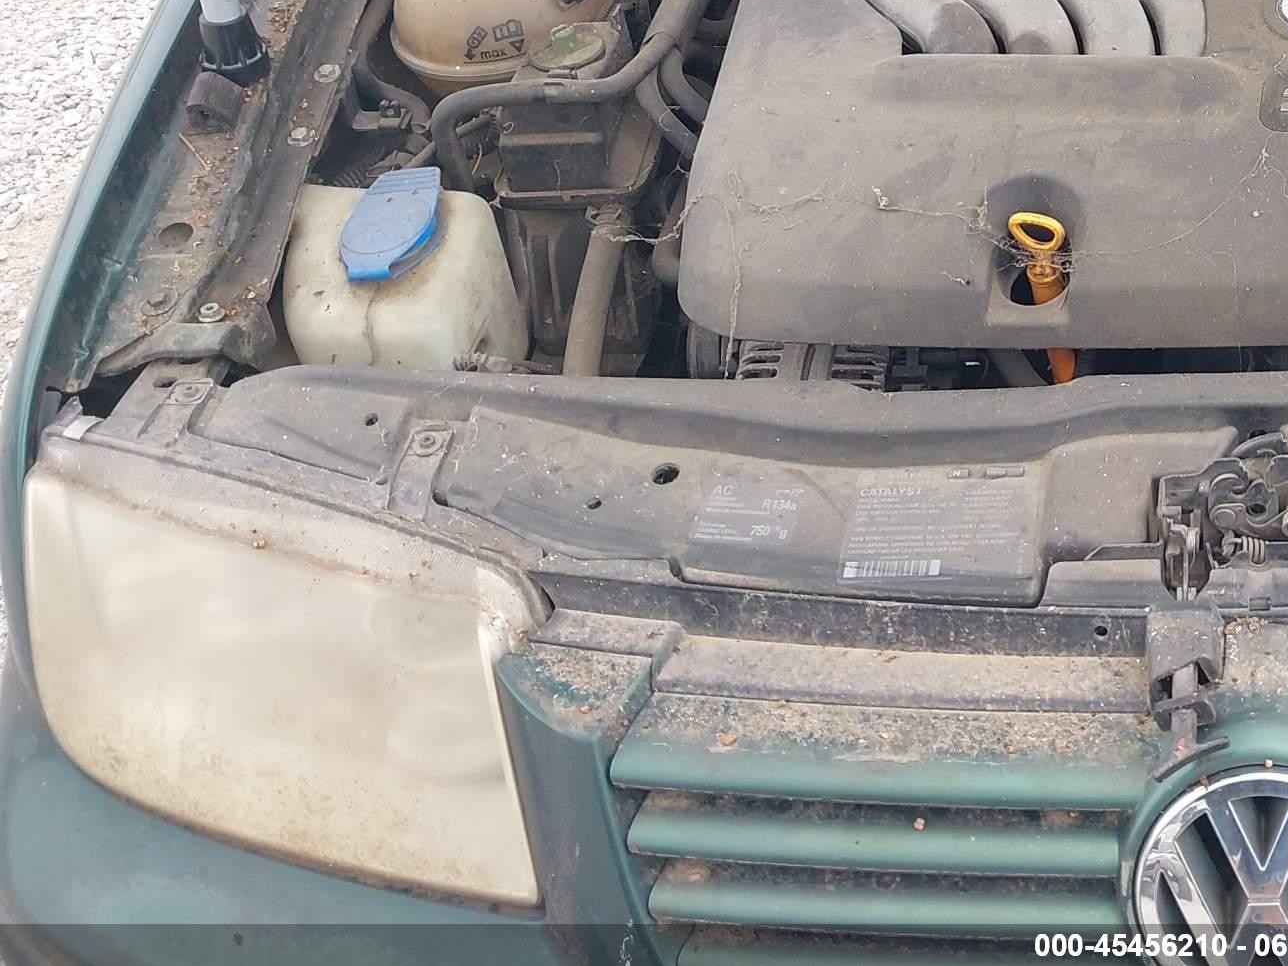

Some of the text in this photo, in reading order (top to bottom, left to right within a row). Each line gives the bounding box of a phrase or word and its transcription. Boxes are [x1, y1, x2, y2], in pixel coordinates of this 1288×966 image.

[480, 49, 507, 59] max
[712, 485, 734, 496] AC
[749, 524, 770, 537] 750
[778, 529, 788, 540] g
